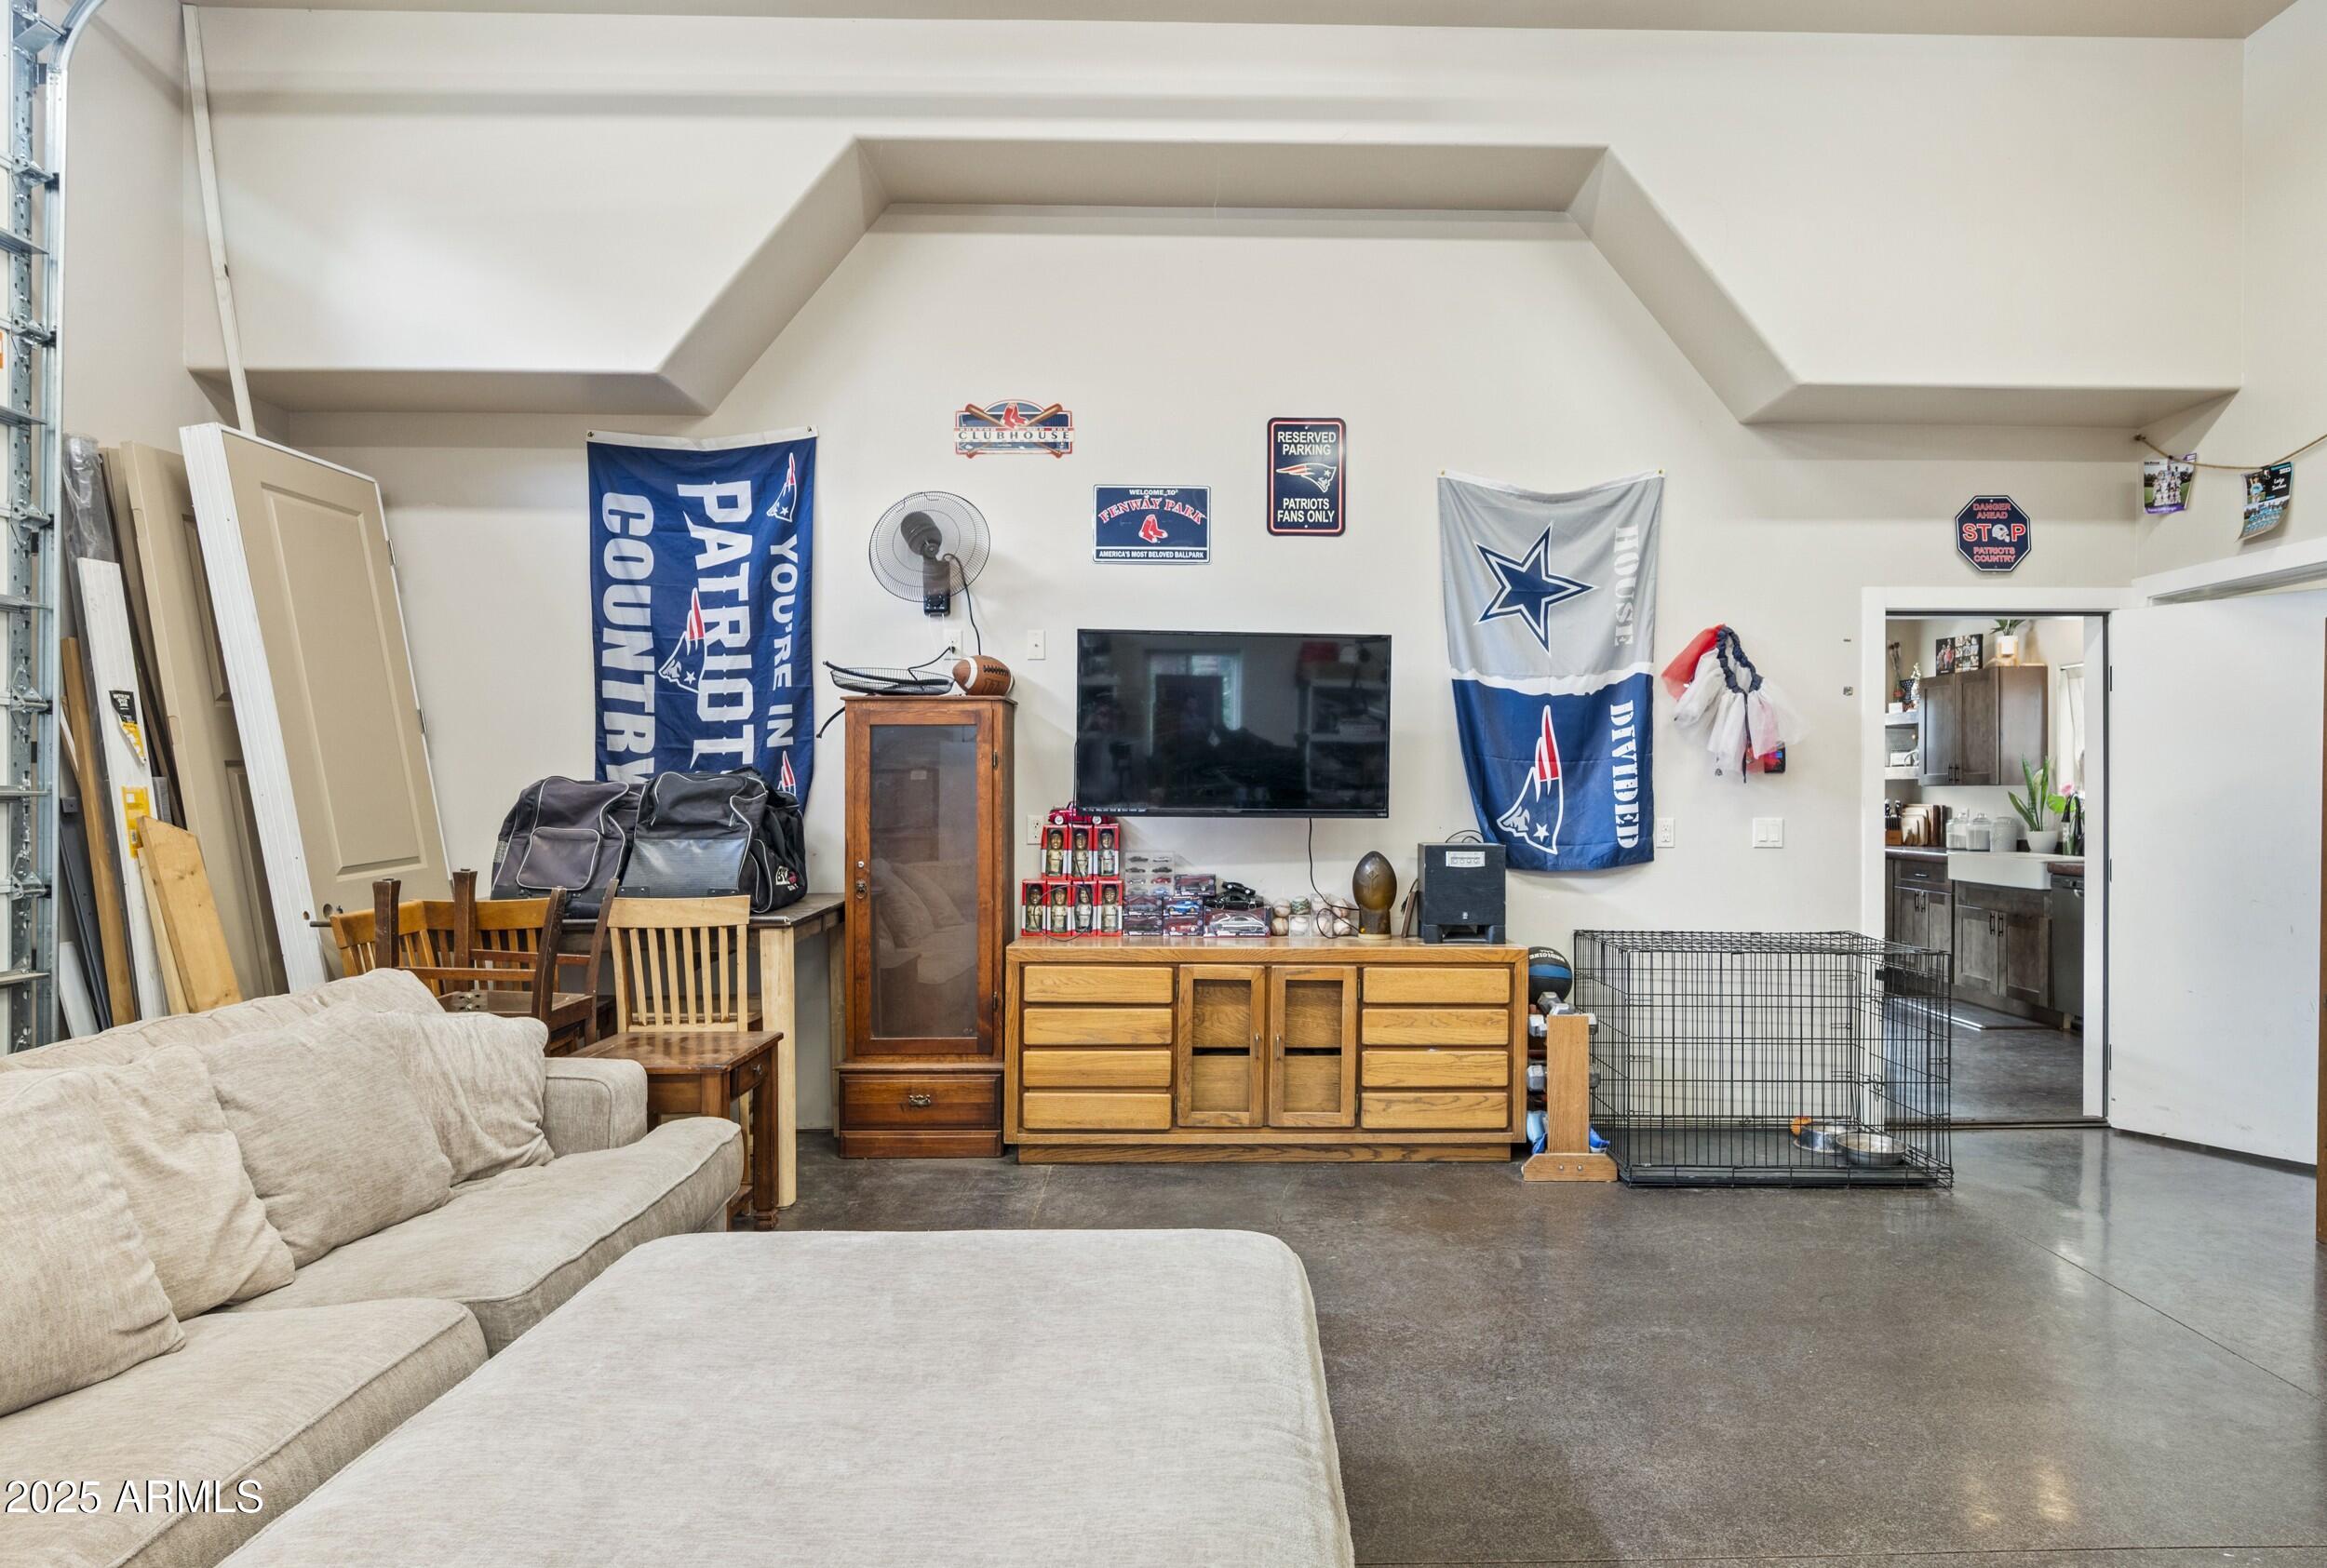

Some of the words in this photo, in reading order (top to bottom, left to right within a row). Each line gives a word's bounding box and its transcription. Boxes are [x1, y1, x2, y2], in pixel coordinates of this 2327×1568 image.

[959, 431, 1069, 440] CLUBHOUSE
[1277, 432, 1337, 443] RESERVED
[1283, 444, 1331, 455] PARKING
[1283, 498, 1330, 510] PATRIOTS
[1972, 503, 2011, 511] DANGER
[1098, 497, 1163, 524] FENWAY
[1164, 499, 1207, 525] PARK
[1277, 510, 1305, 522] FANS
[1307, 510, 1335, 522] ONLY
[1976, 511, 2009, 519] AHEAD
[1099, 550, 1131, 558] AMERICA'S
[1972, 546, 2016, 555] PATRIOTS
[1973, 555, 2016, 563] COUNTRY
[1613, 523, 1639, 648] HOUSE
[768, 533, 799, 692] YOU'RE
[676, 479, 755, 774] PATRIOT
[766, 705, 794, 747] IN
[1610, 700, 1639, 850] DIVIDED
